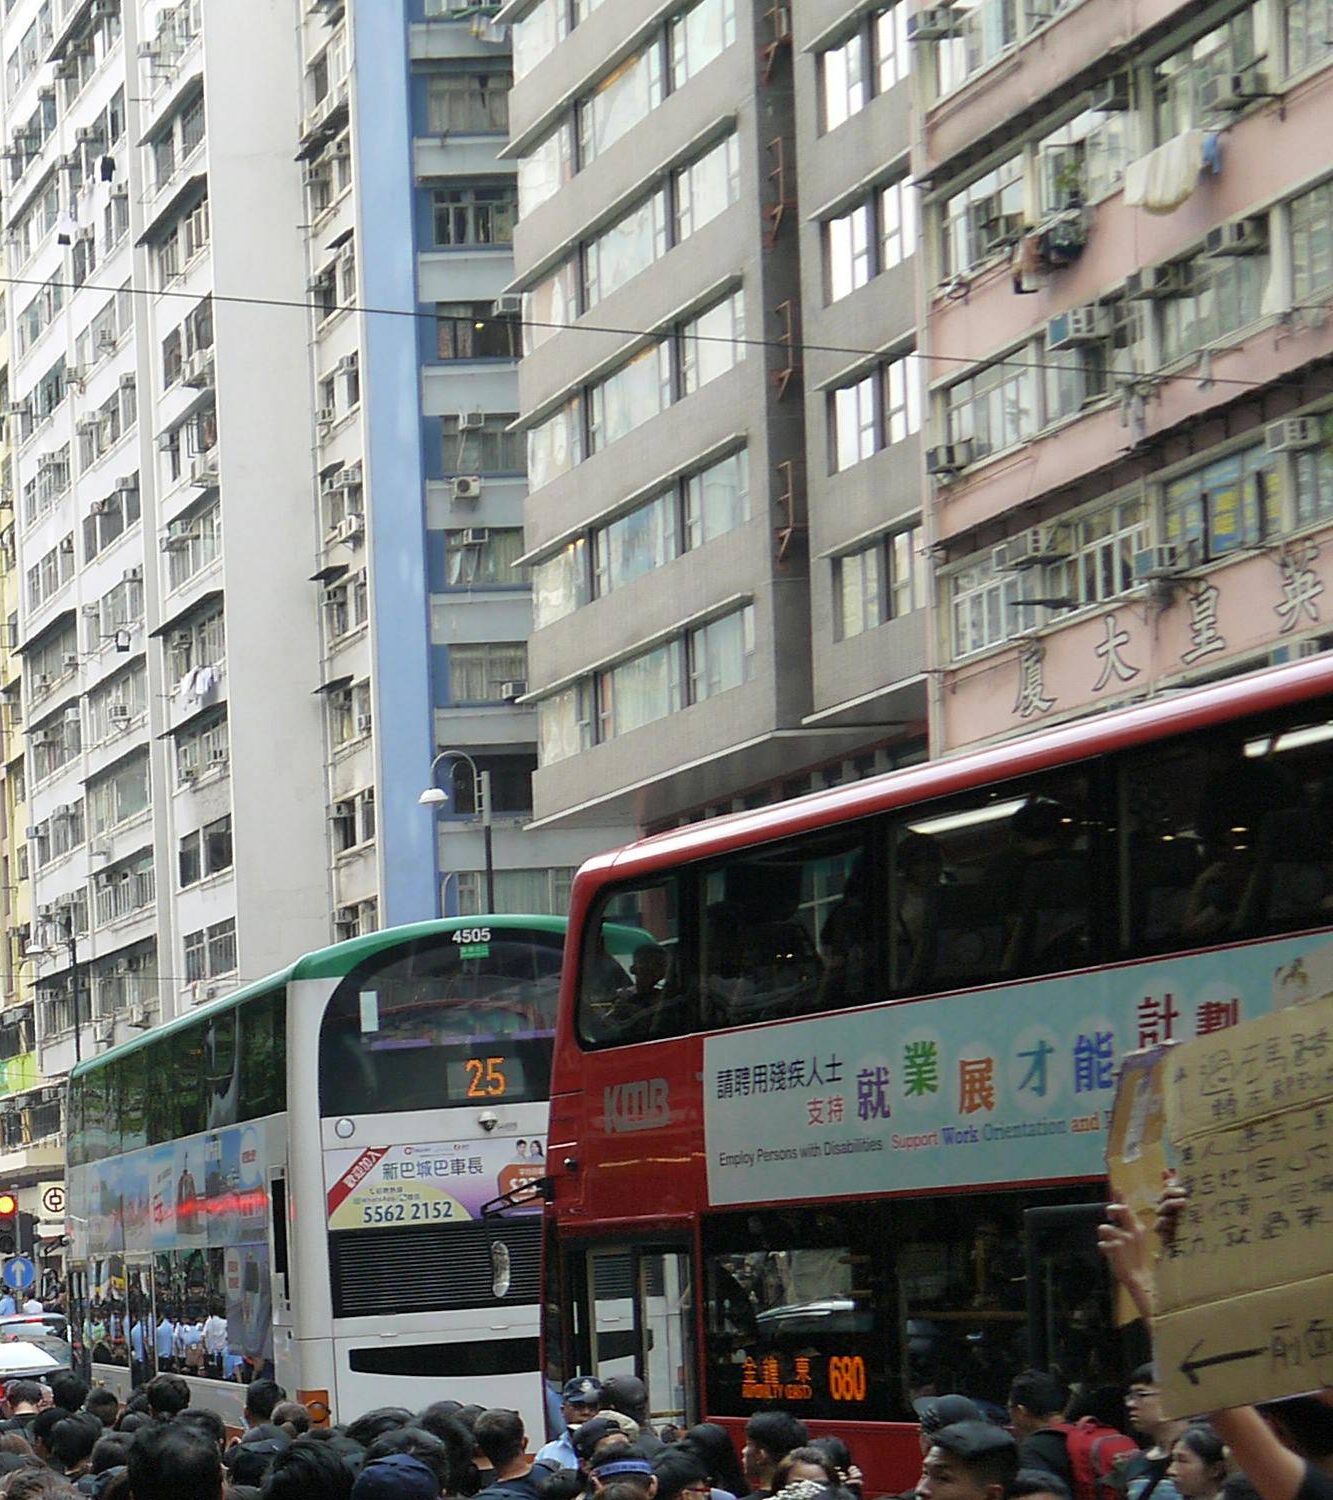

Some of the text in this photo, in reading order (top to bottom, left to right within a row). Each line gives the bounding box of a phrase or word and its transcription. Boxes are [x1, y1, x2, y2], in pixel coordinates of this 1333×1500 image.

[452, 928, 492, 944] 4505
[464, 1057, 507, 1098] 25
[716, 1053, 843, 1099] 請聘用殘疾人士
[604, 1077, 670, 1135] KMB
[807, 1095, 844, 1126] 支持
[719, 1148, 755, 1168] Employ
[757, 1143, 798, 1163] Persons
[800, 1142, 823, 1159] with
[824, 1137, 883, 1158] Disabilities
[891, 1131, 939, 1153] Support
[942, 1126, 978, 1146] Work
[983, 1118, 1066, 1143] Orientation
[1071, 1114, 1100, 1135] and
[382, 1156, 484, 1180] 新巴城巴車長
[363, 1201, 453, 1223] 5562 2152
[794, 1355, 812, 1384] 東
[828, 1355, 867, 1401] 680
